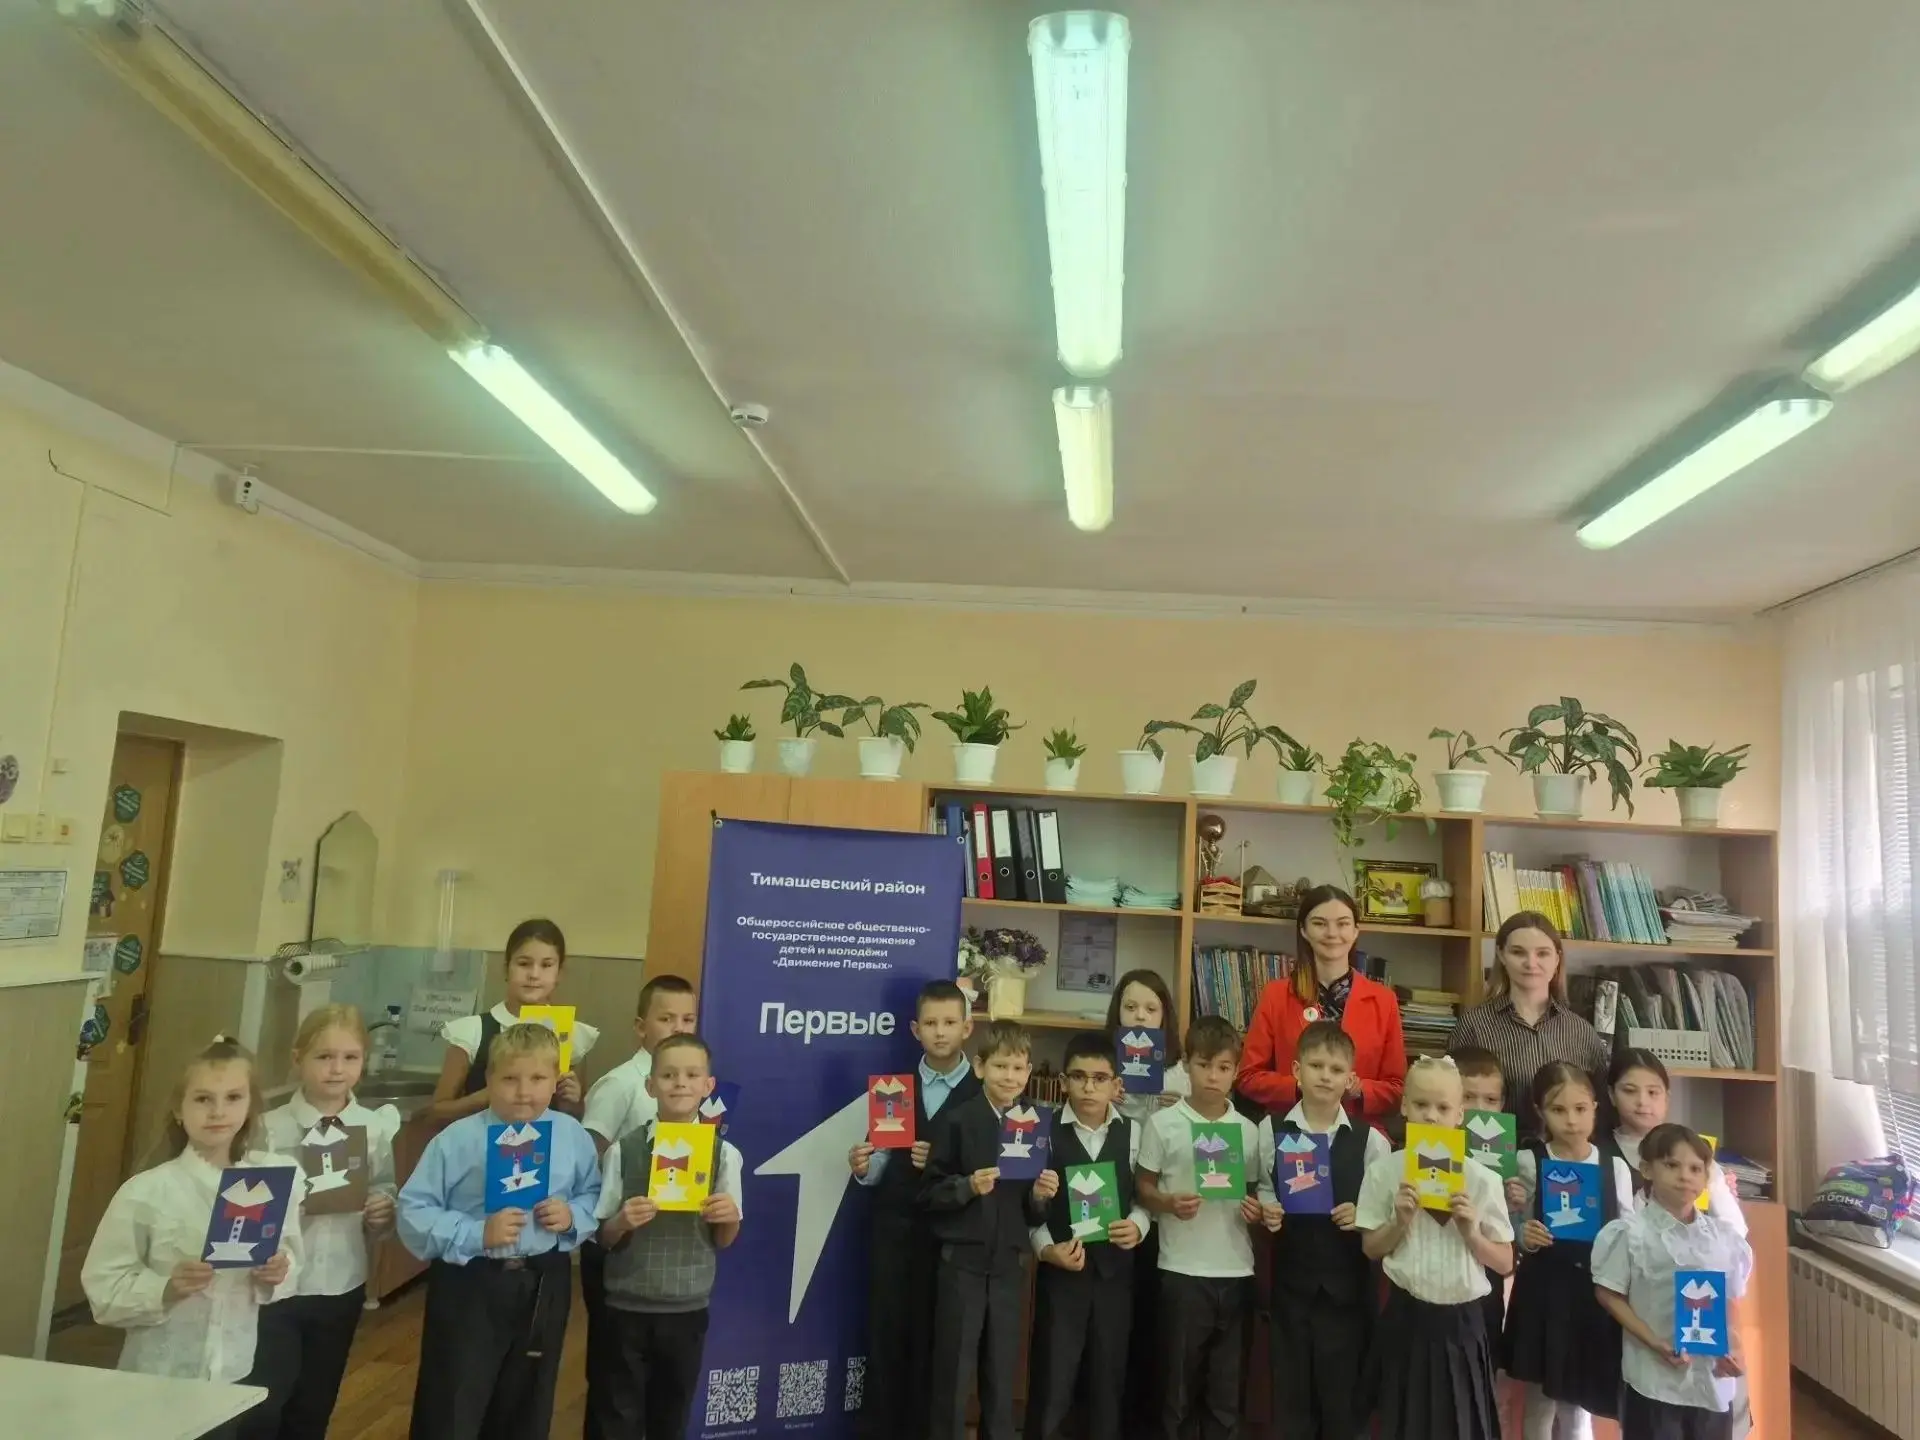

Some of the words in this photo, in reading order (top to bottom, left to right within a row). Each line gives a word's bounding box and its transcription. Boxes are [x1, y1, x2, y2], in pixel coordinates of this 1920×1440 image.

[751, 873, 871, 892] Тимашевский
[874, 880, 925, 895] район
[736, 917, 845, 930] Общероссийское
[847, 922, 931, 934] общественно-
[752, 930, 856, 943] государственное
[857, 937, 916, 946] движение
[779, 945, 816, 955] детей
[827, 947, 888, 957] молодёжи
[773, 957, 841, 969] «Движение
[843, 960, 893, 970] Первых»
[760, 1002, 895, 1044] Первые
